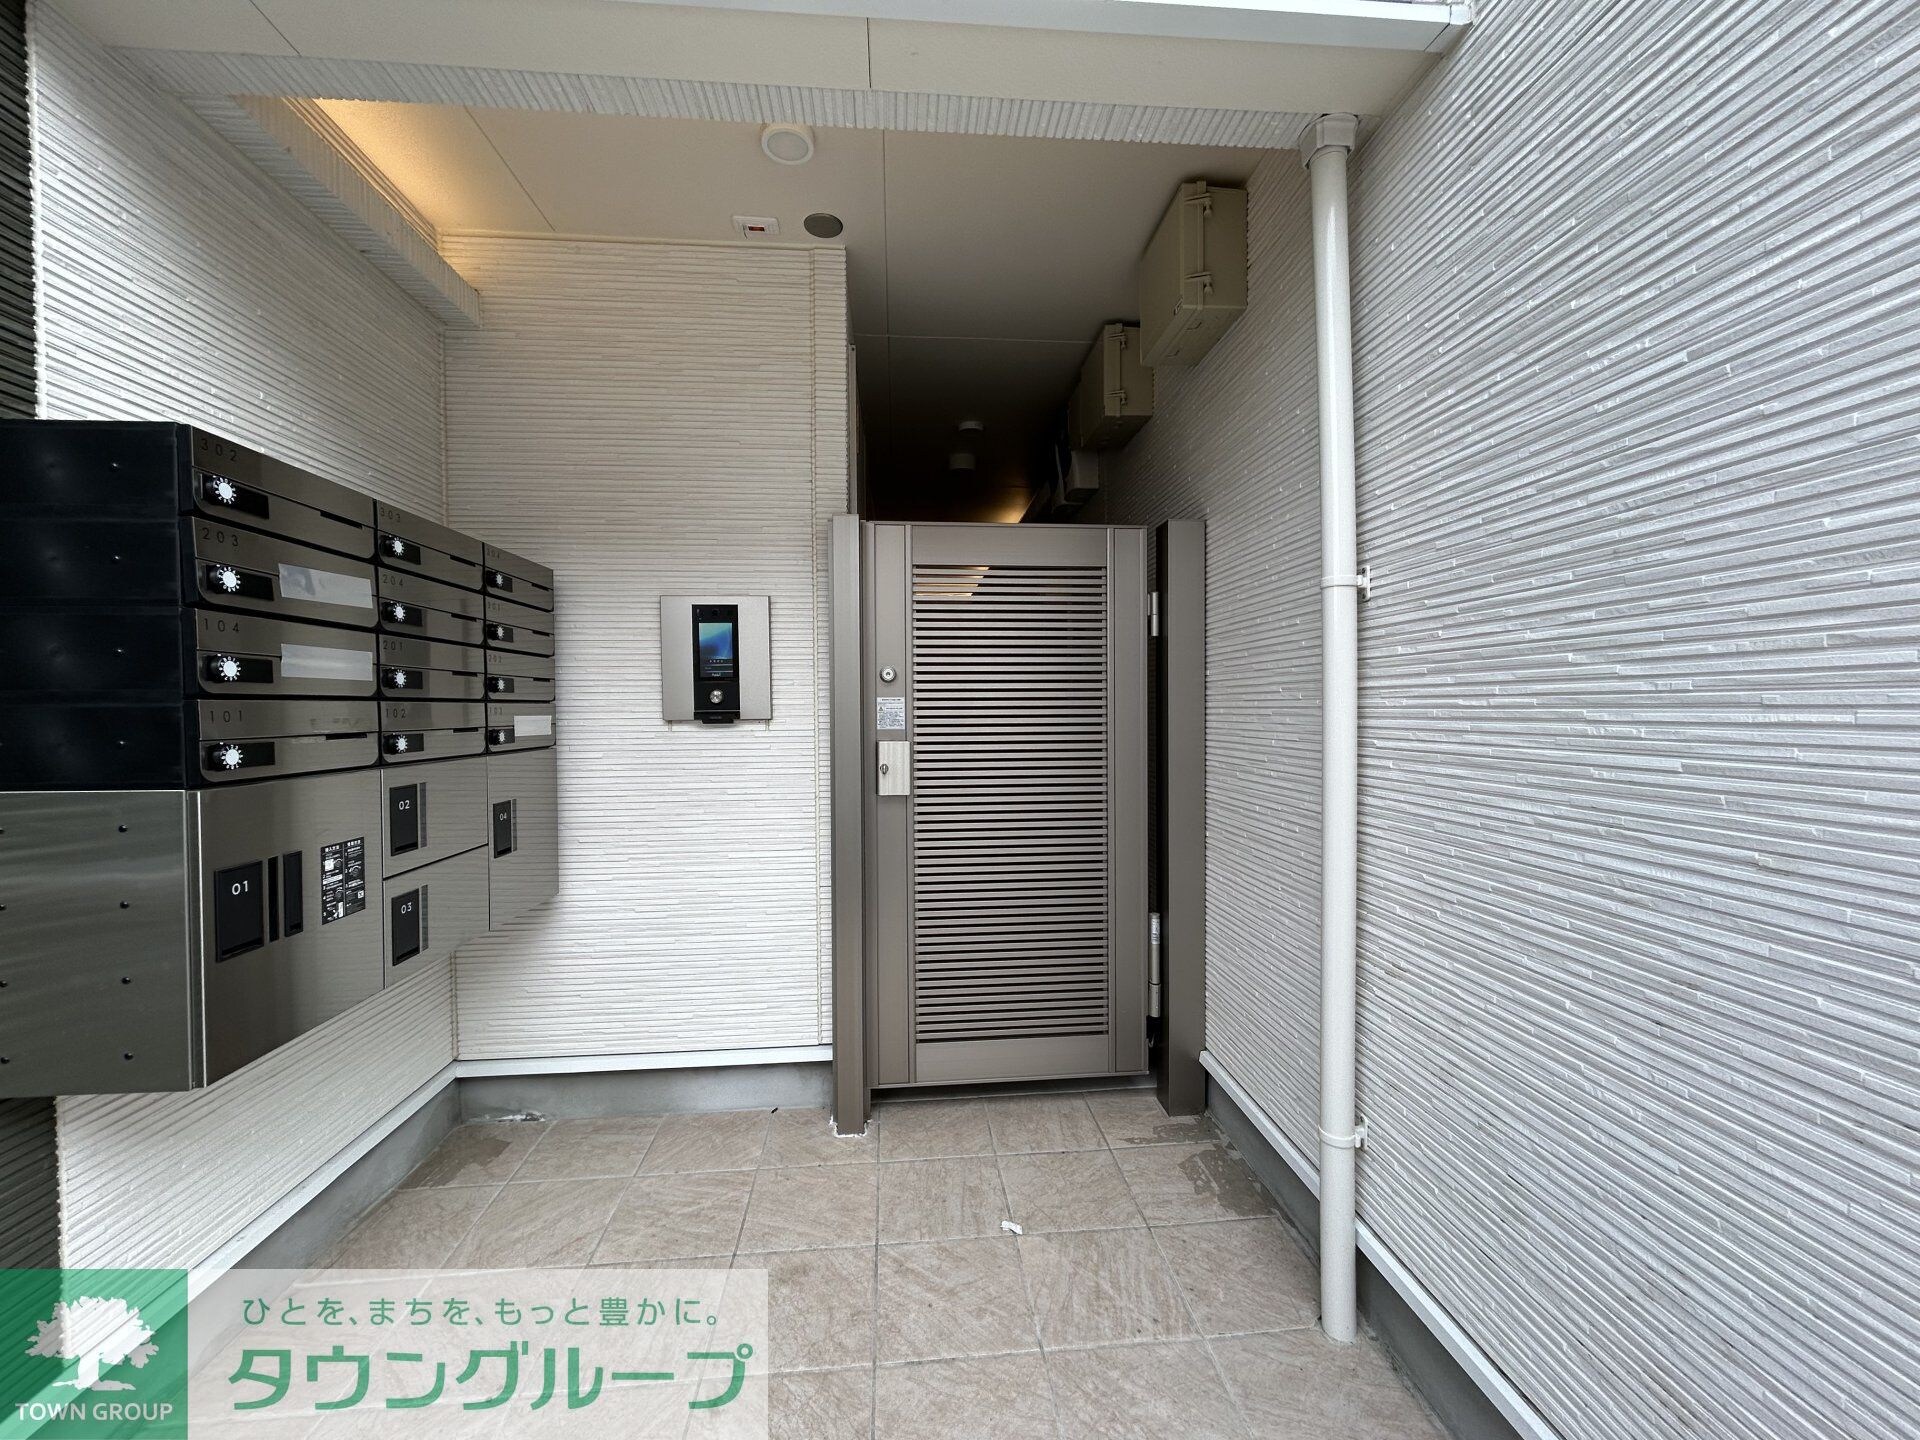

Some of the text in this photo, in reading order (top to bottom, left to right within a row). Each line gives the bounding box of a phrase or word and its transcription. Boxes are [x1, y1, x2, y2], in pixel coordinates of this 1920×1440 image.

[200, 438, 238, 462] 302
[201, 527, 239, 547] 203
[202, 618, 241, 633] 104
[209, 709, 244, 724] 101
[385, 708, 407, 719] 102
[398, 800, 411, 811] 02
[499, 812, 508, 821] 04
[231, 880, 250, 896] 01
[400, 902, 413, 915] 03
